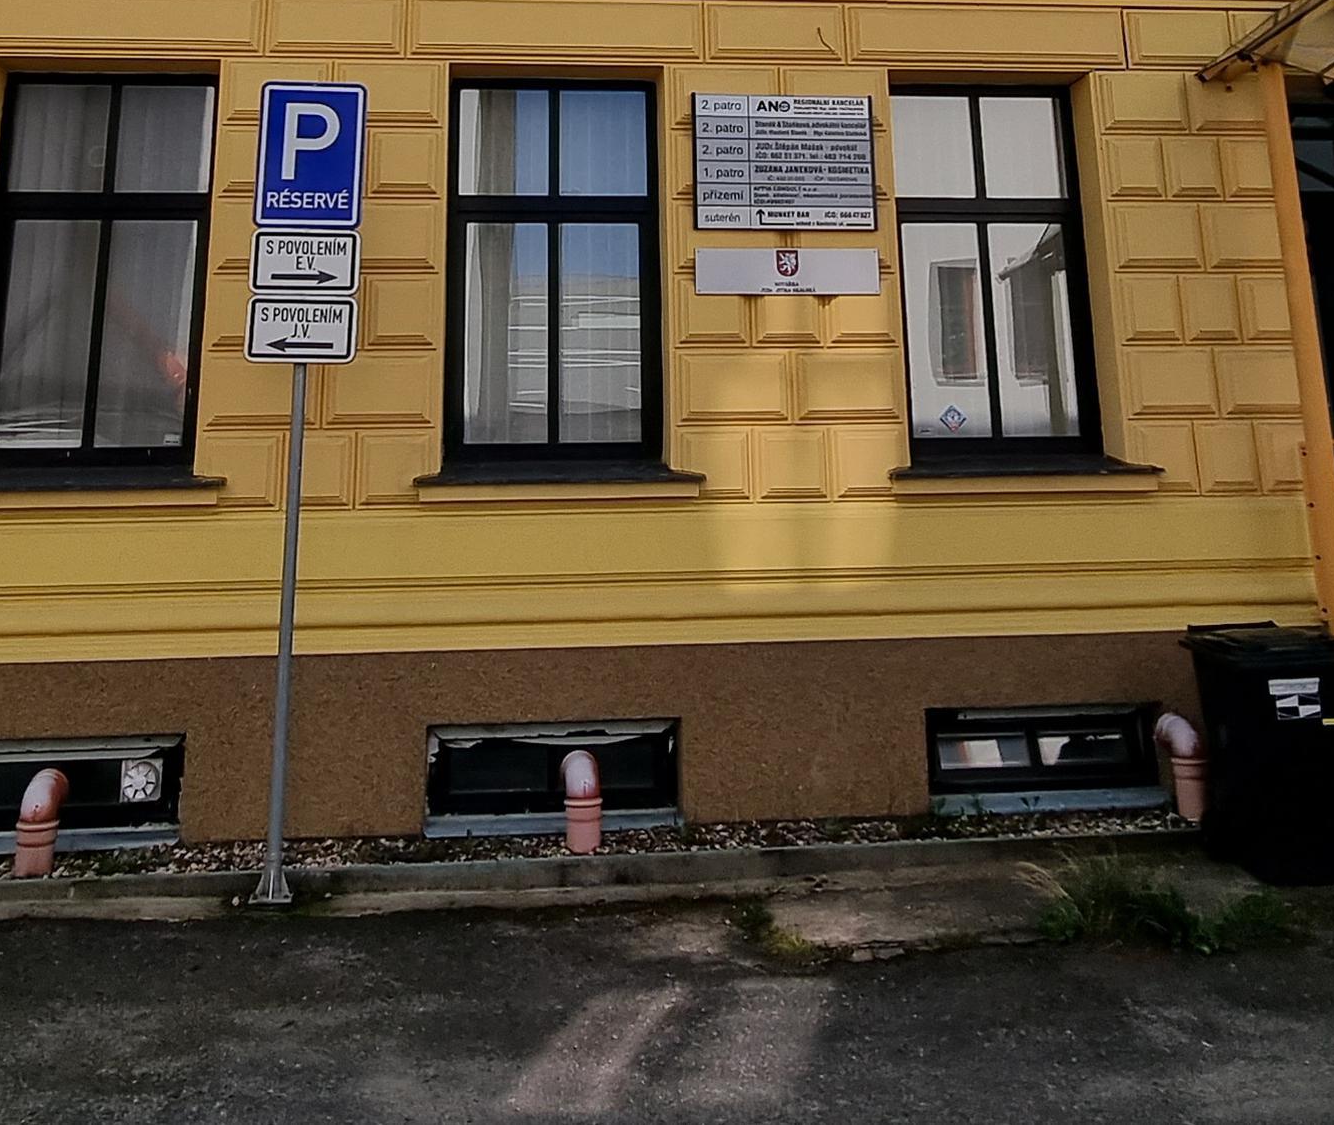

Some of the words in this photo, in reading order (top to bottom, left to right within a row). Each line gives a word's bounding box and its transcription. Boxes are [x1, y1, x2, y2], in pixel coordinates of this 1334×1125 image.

[713, 101, 742, 112] patro
[756, 100, 791, 113] ANO
[701, 122, 713, 133] 2.
[715, 124, 744, 135] patro
[280, 102, 341, 181] P
[701, 144, 713, 155] 2.
[715, 146, 744, 156] patro
[703, 167, 713, 179] 1.
[716, 168, 745, 180] patro
[827, 166, 870, 174] KOSMETIKA
[266, 188, 349, 209] RÉSERVÉ
[702, 189, 744, 202] přízemí
[704, 212, 741, 222] suterén
[266, 239, 274, 255] S
[277, 238, 347, 256] POVOLENÍM
[295, 255, 316, 271] E.V.
[261, 307, 269, 322] S
[273, 305, 343, 324] POVOLENÍM
[290, 323, 310, 339] J.V.
